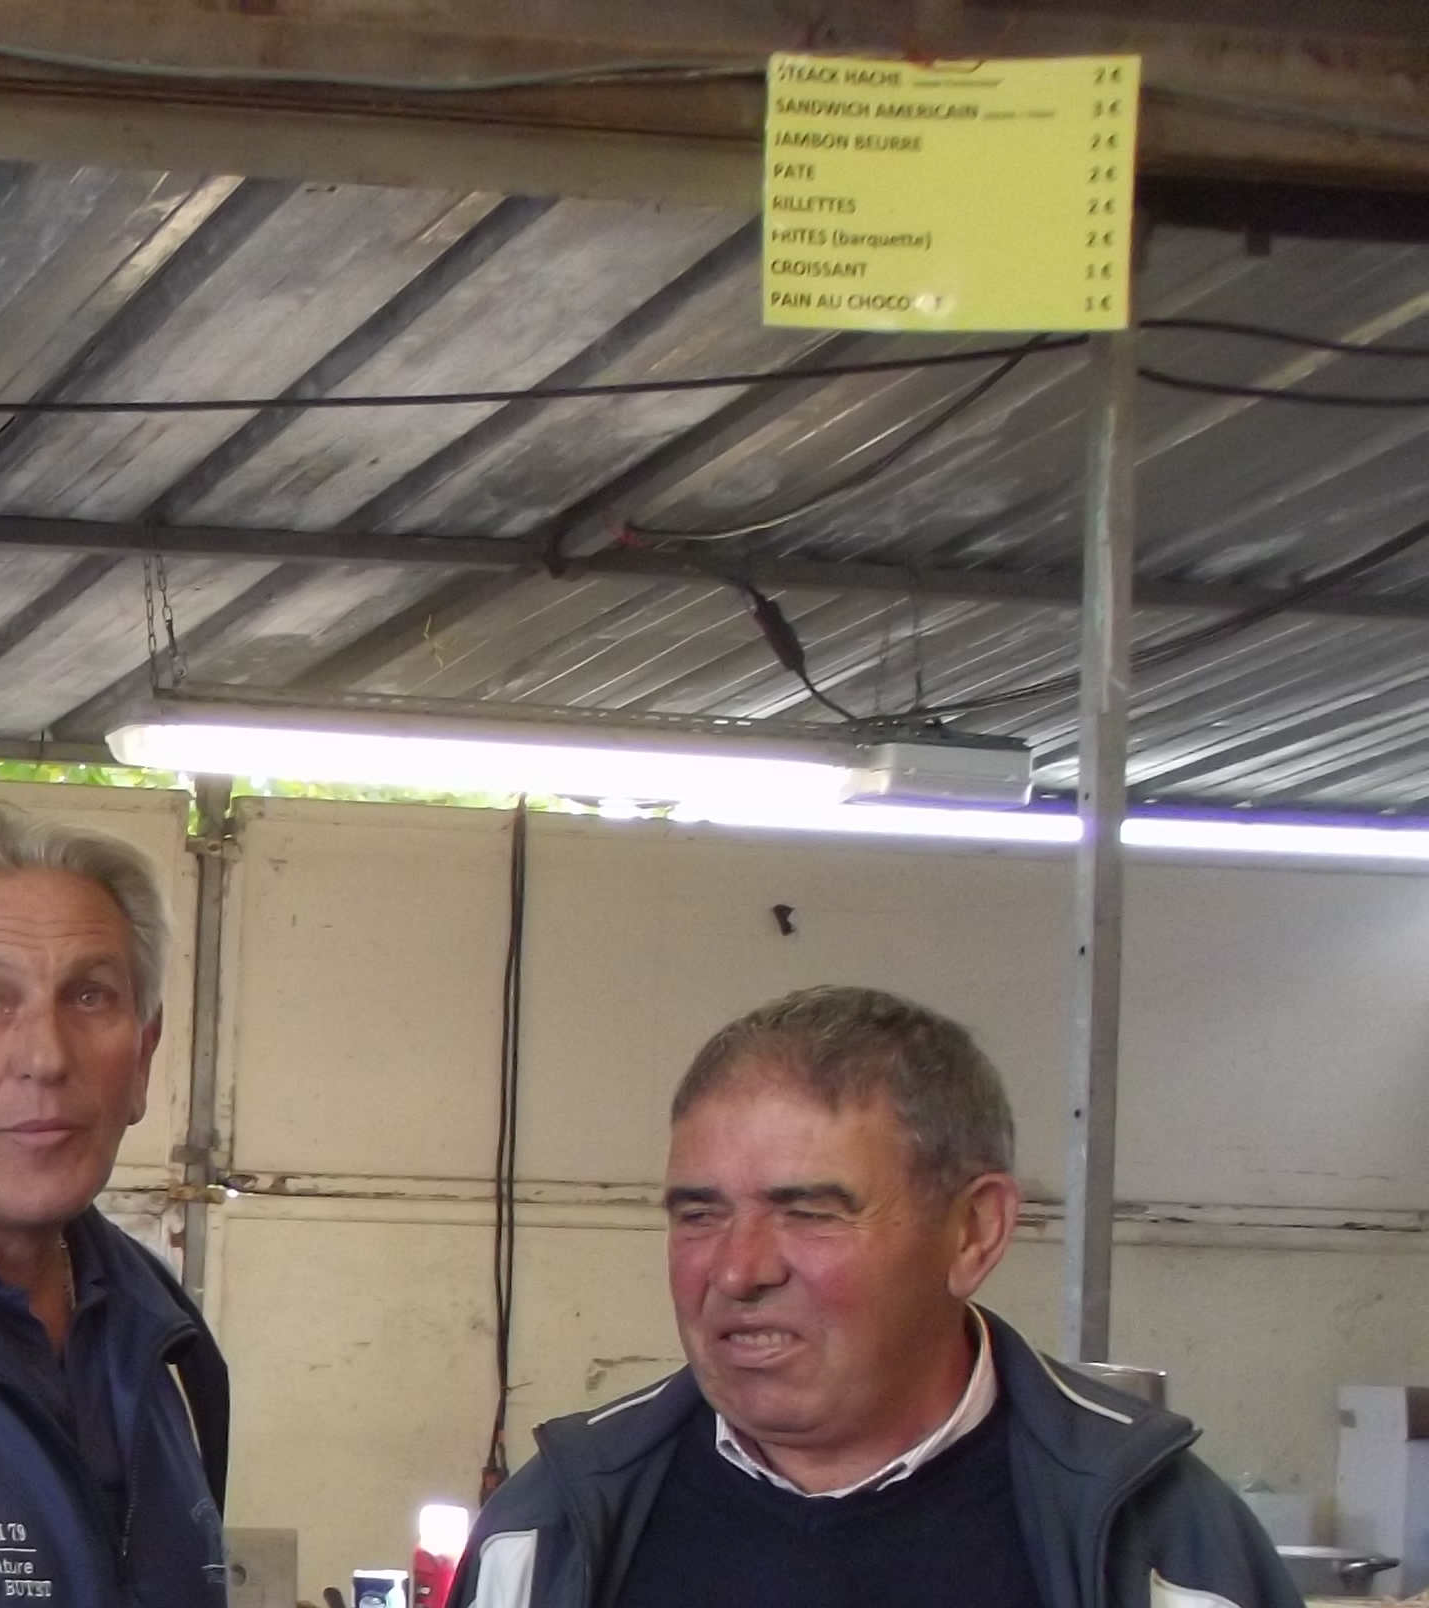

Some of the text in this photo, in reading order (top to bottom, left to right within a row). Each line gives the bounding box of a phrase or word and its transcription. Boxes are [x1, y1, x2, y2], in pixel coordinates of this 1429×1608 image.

[1093, 67, 1106, 84] 2
[776, 98, 870, 117] SANDWICH
[875, 102, 979, 120] AMERICAIN
[775, 131, 849, 149] JAMBON
[854, 134, 922, 152] BEURRE
[1090, 133, 1102, 151] 2
[1088, 165, 1101, 184] 2
[772, 194, 856, 214] RILLETTES
[1087, 197, 1099, 216] 2
[771, 228, 827, 246] FRITES
[832, 228, 932, 251] (barquette)
[1086, 230, 1097, 248] 2
[770, 260, 867, 278] CROISSANT
[770, 291, 811, 308] PAIN
[817, 293, 841, 310] AU
[847, 294, 943, 312] CHOCOT
[7, 1523, 27, 1541] 79
